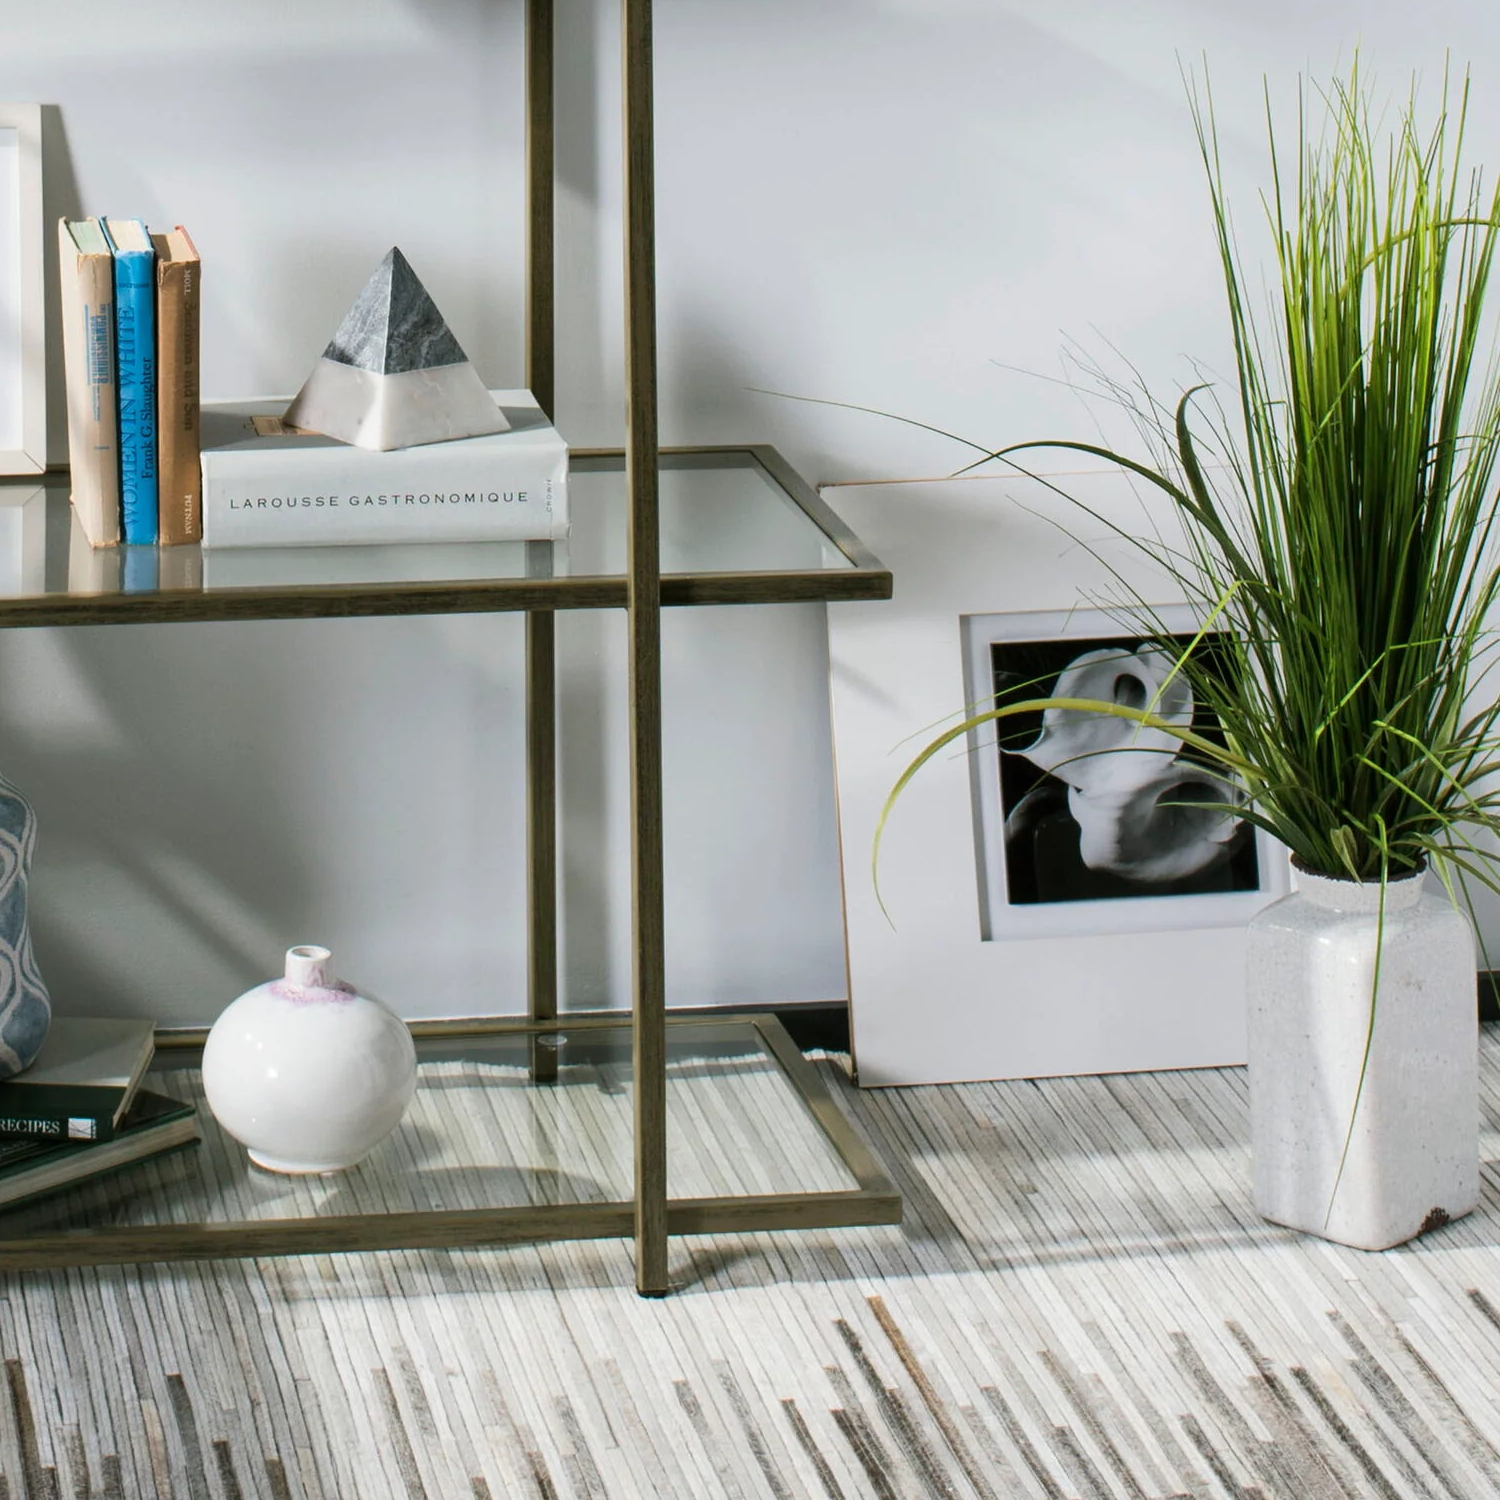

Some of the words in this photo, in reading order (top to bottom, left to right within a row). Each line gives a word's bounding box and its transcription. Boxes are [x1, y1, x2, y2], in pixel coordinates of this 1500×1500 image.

[183, 269, 192, 296] MOLL
[90, 315, 109, 385] COMMISSIONER
[116, 304, 137, 388] WHITE
[139, 356, 156, 421] Slaughter
[118, 397, 138, 427] IN
[120, 429, 140, 526] WOMEN
[140, 442, 154, 479] Frank
[183, 494, 193, 535] PUTNAM
[230, 496, 339, 509] LAROUSSE
[349, 491, 529, 507] GASTRONOMIQUE
